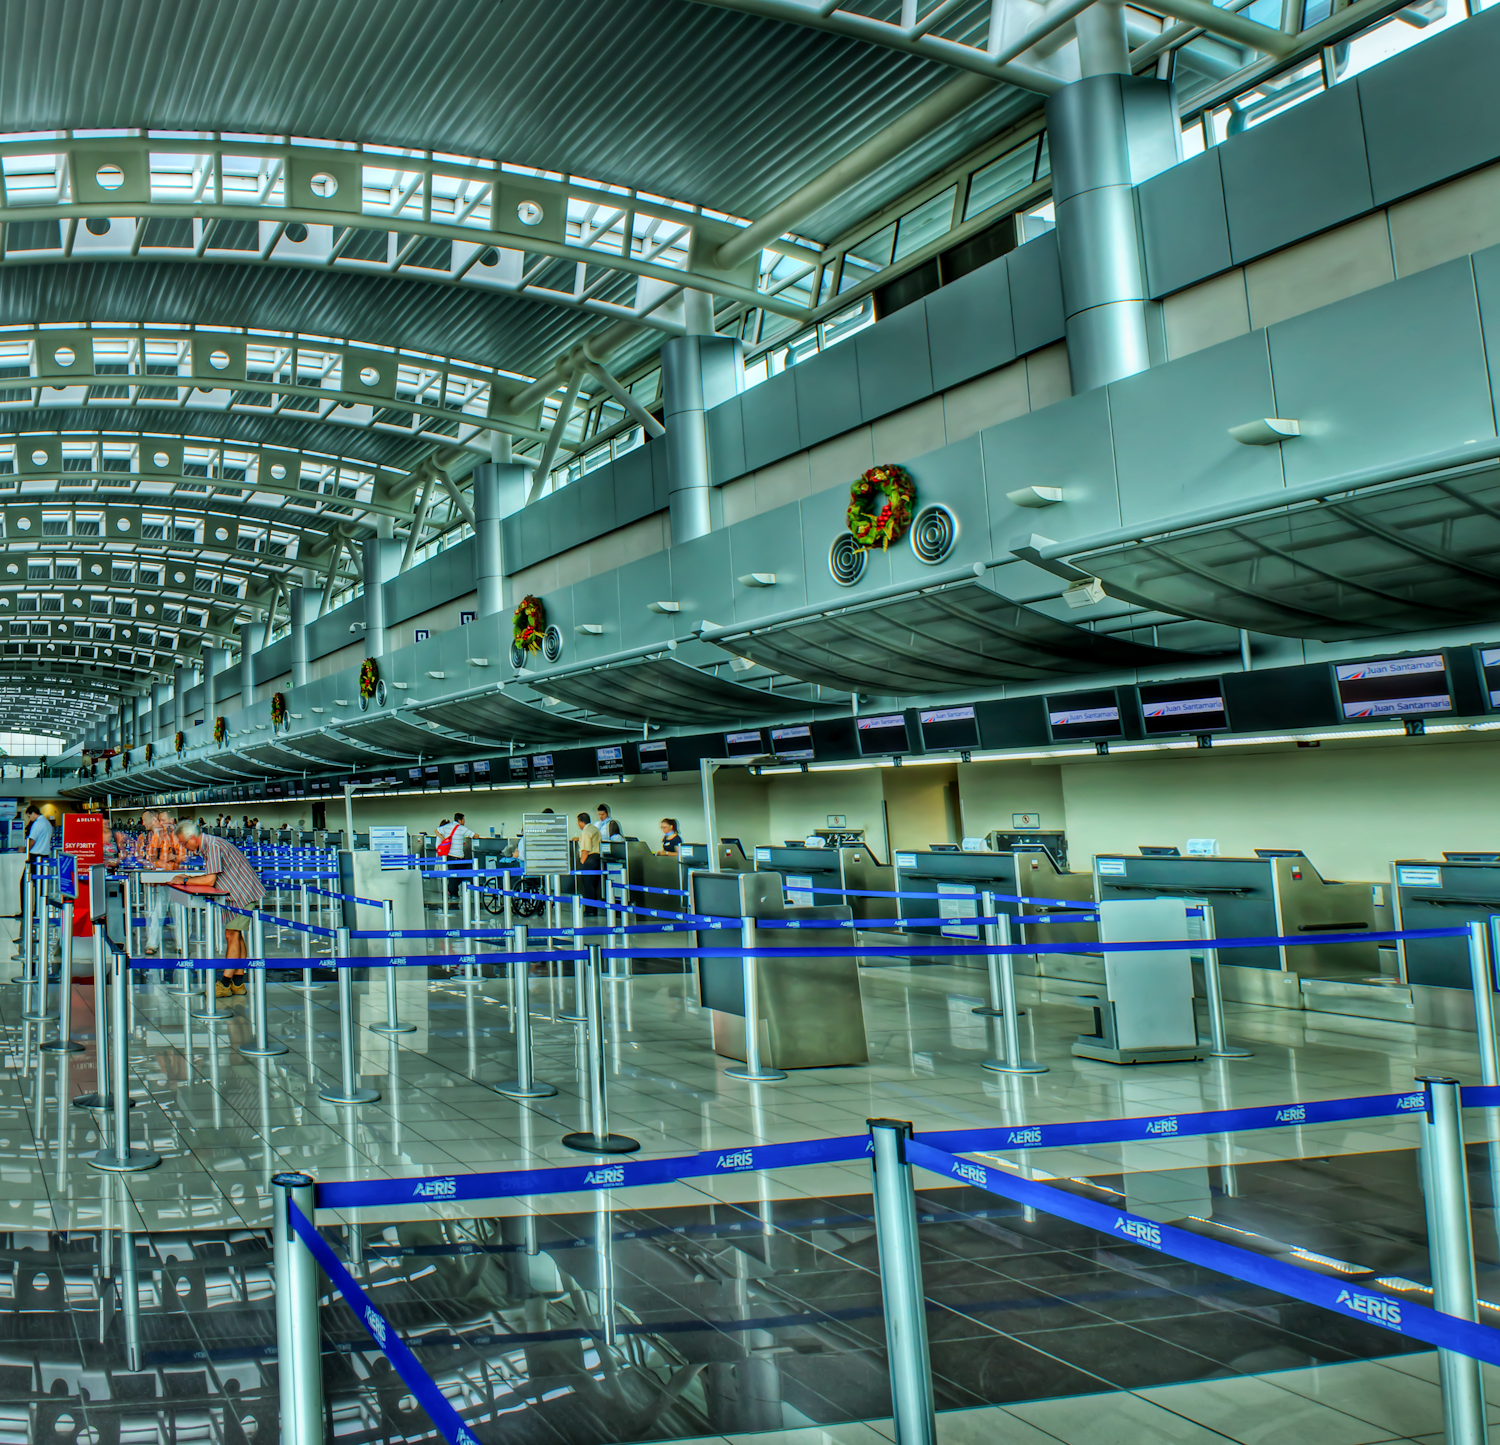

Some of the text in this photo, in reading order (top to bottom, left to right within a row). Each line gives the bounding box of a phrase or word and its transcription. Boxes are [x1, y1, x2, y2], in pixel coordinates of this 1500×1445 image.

[1367, 666, 1387, 674] Juan
[1165, 704, 1180, 712] Juan
[1374, 704, 1394, 712] Juan
[1406, 723, 1423, 735] 12
[1197, 737, 1211, 747] 13
[1096, 743, 1108, 754] 14
[961, 751, 971, 759] 15
[893, 757, 901, 766] 16
[387, 930, 403, 938] AERIS
[445, 929, 460, 937] AERIS
[176, 959, 194, 967] AERIS
[247, 959, 265, 967] AERIS
[318, 958, 336, 967] AERIS
[389, 956, 406, 965] AERIS
[459, 954, 476, 963] AERIS
[1396, 1093, 1425, 1109] AERIS
[1275, 1105, 1306, 1121] AERIS
[1145, 1117, 1178, 1133] AERIS
[1007, 1127, 1042, 1143] AERIS
[716, 1149, 753, 1168] AERIS
[583, 1165, 624, 1185] AERIS
[951, 1161, 987, 1184] AERIS
[412, 1177, 456, 1197] AERIS
[1114, 1216, 1162, 1245] AERIS
[1335, 1289, 1402, 1324] AERIS
[1367, 1315, 1402, 1331] COSTA RICA
